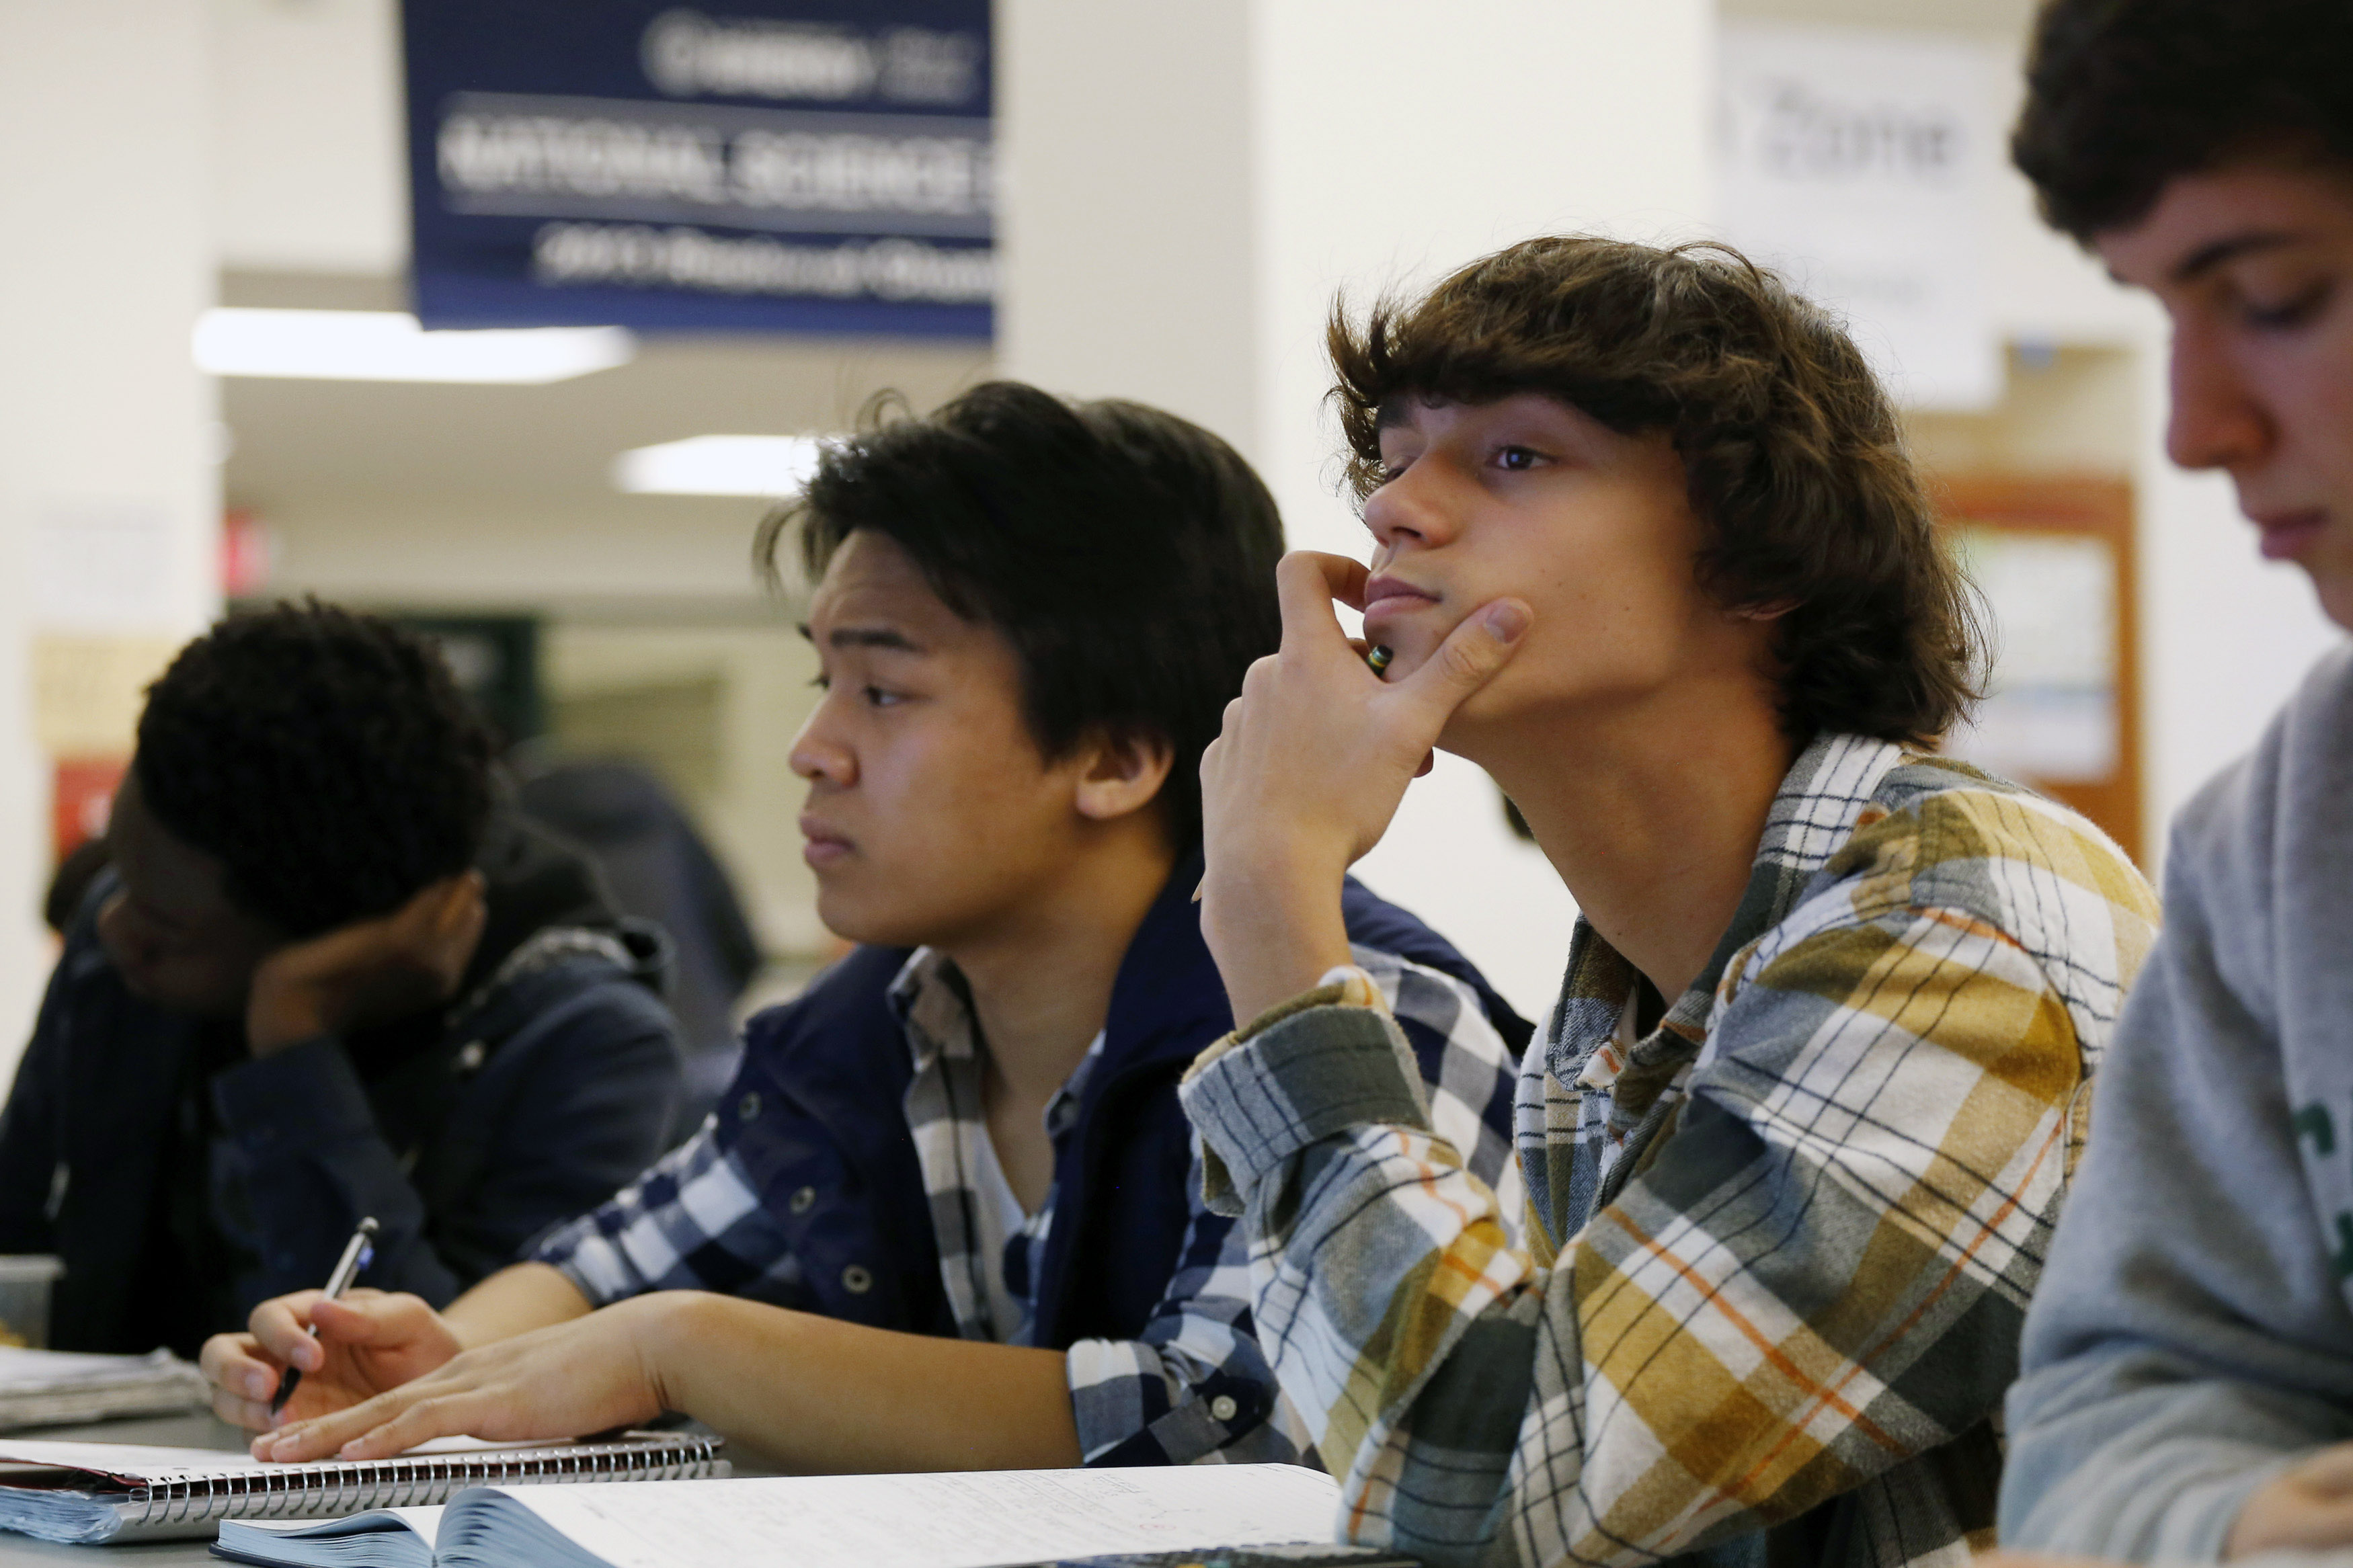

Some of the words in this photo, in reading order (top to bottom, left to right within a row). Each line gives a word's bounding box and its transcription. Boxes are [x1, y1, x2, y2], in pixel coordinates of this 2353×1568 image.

[438, 113, 730, 207] NATIONAL
[734, 128, 975, 216] SCIENCE
[1760, 82, 1960, 183] Zone
